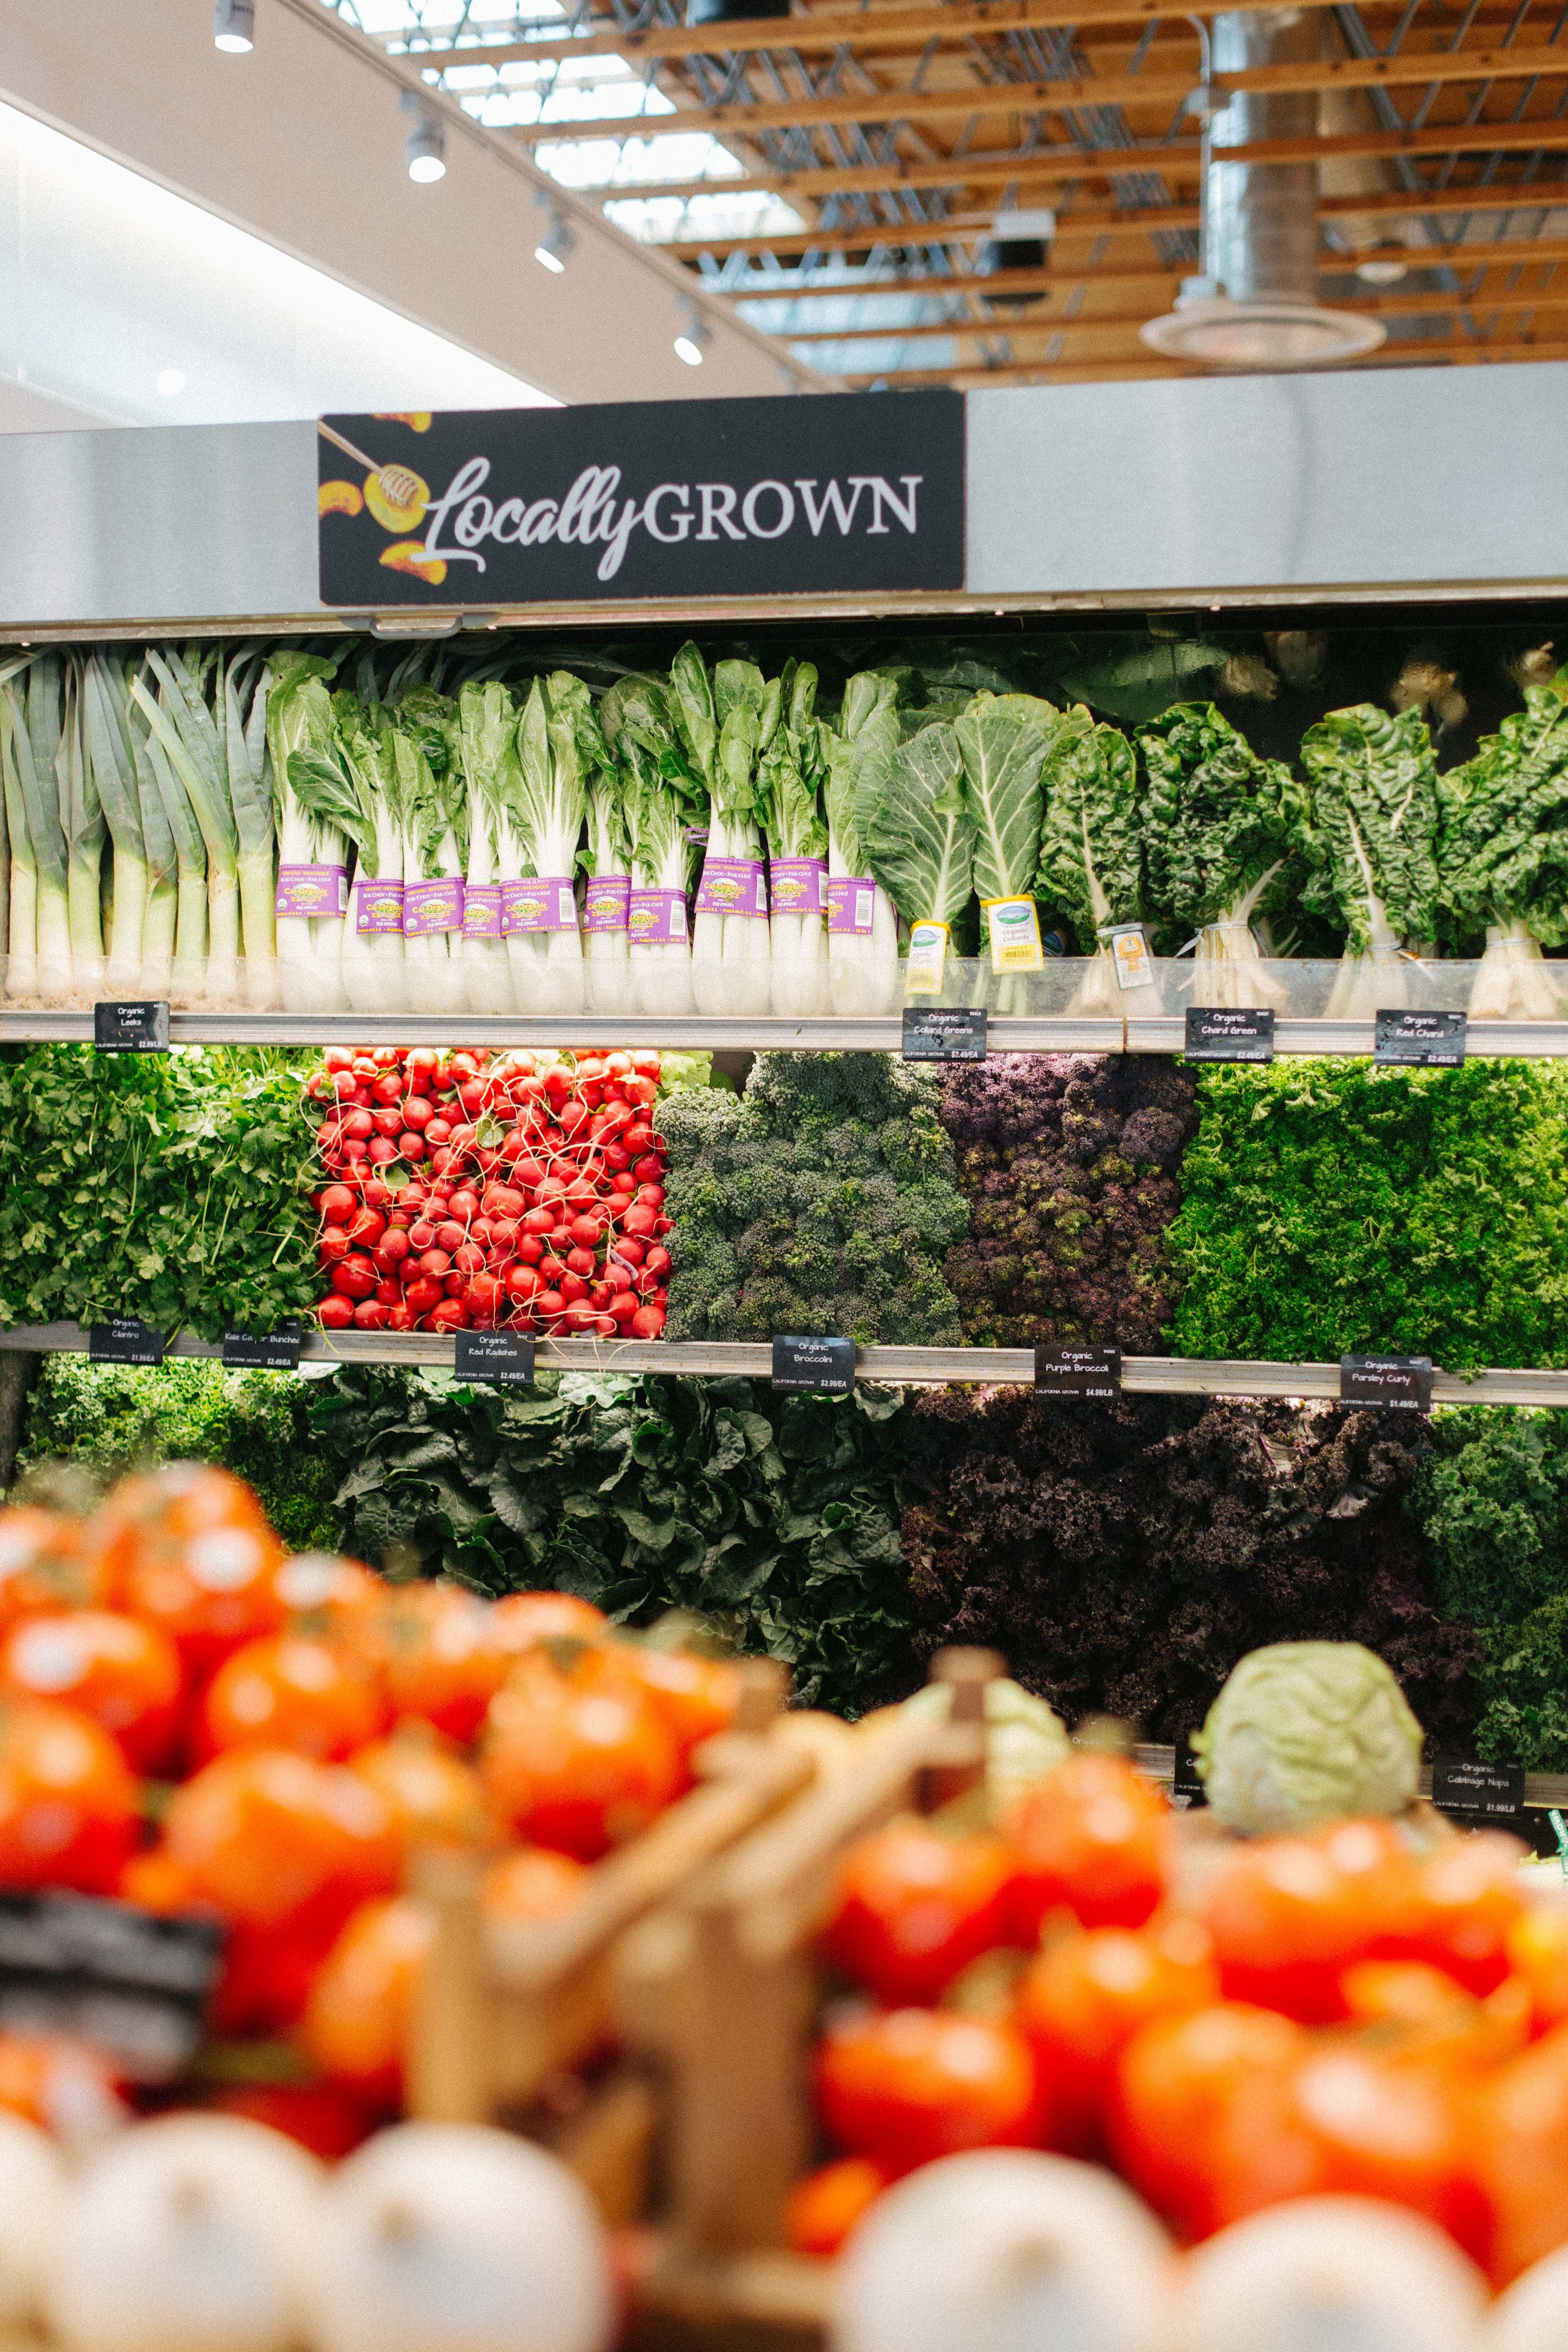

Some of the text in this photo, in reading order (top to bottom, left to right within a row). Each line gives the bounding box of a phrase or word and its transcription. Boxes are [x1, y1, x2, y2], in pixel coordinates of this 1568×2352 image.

[409, 457, 923, 581] Locally GROWN
[118, 1007, 145, 1018] Organic
[929, 1014, 959, 1025] Organic
[1214, 1014, 1246, 1025] Organic
[1404, 1016, 1437, 1028] Organic
[1417, 1029, 1444, 1038] Chard
[113, 1319, 139, 1330] Organic
[112, 1330, 139, 1339] Cilantro
[479, 1336, 507, 1347] Organic
[799, 1343, 829, 1353] Organic
[1062, 1352, 1093, 1362] Organic
[1046, 1364, 1071, 1374] Purple
[1365, 1361, 1398, 1372] Organic
[1352, 1374, 1410, 1386] Parsley Curly
[1390, 1400, 1418, 1408] $1.49/EA
[1463, 1764, 1495, 1775] Organic
[1448, 1776, 1509, 1789] Cabbage Napa
[1487, 1804, 1515, 1812] $1.99/LB
